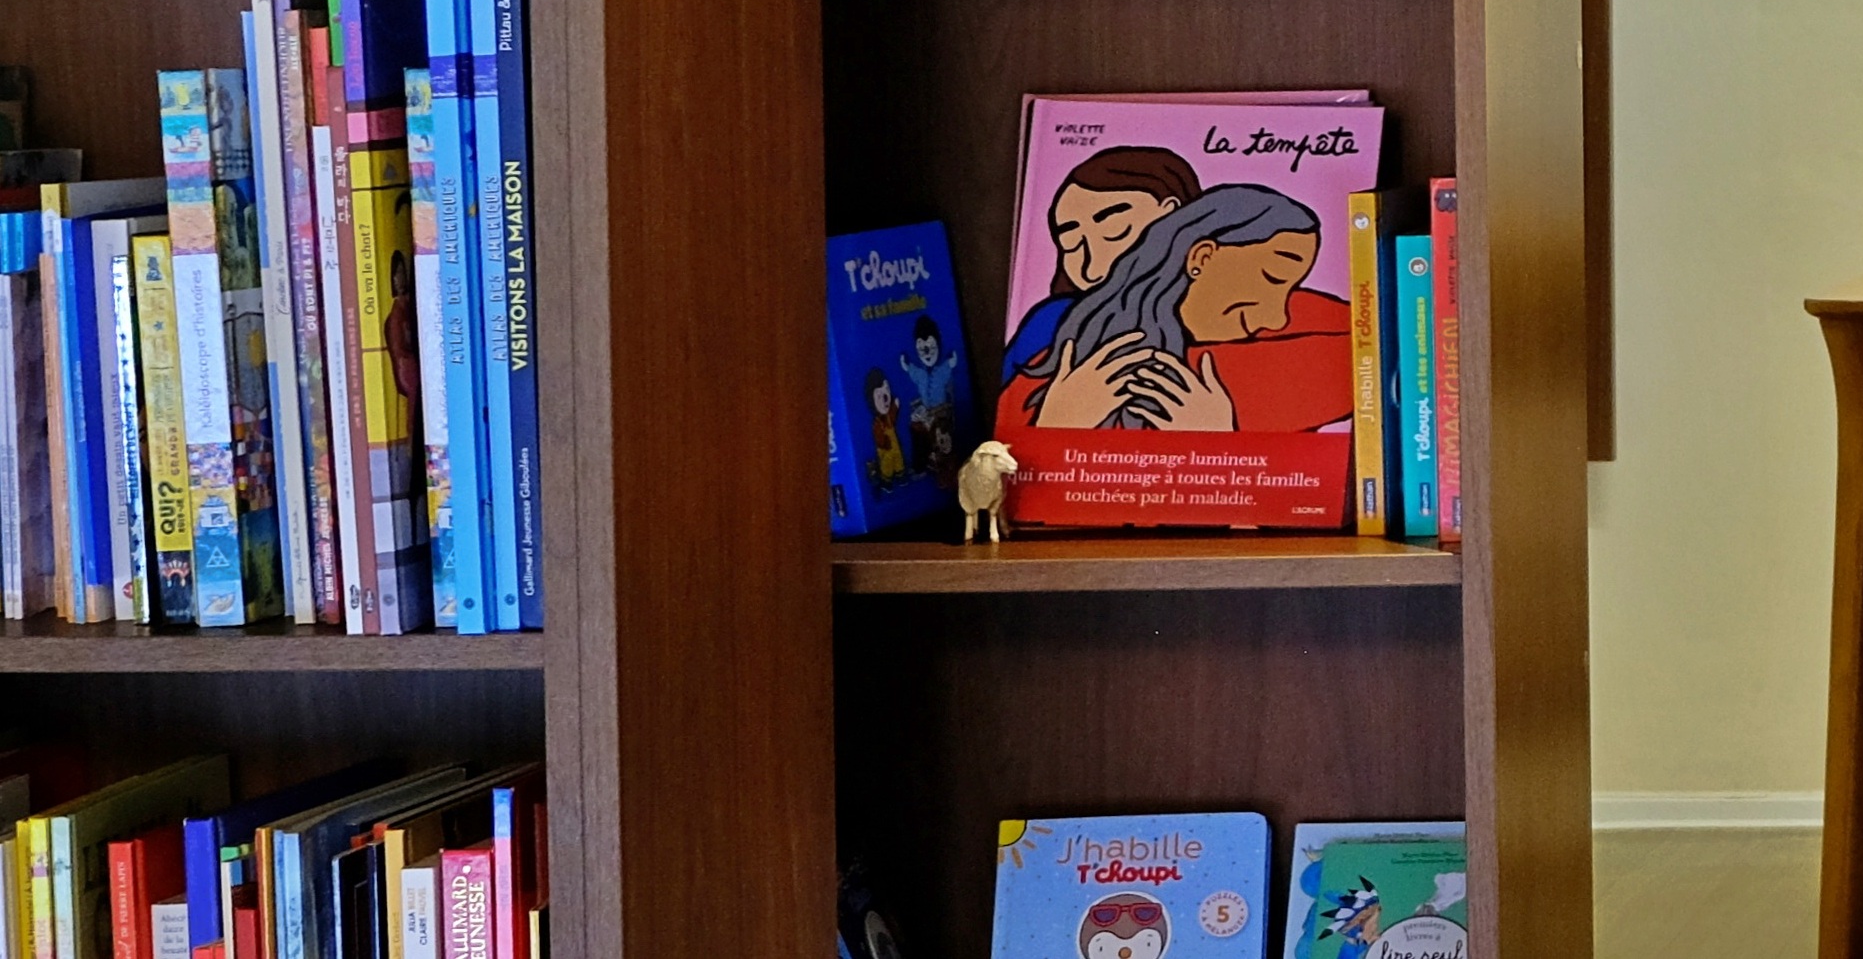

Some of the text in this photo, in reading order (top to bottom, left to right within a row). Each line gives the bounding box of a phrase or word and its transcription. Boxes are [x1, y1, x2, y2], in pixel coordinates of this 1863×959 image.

[499, 12, 513, 51] Pittau
[1203, 125, 1360, 173] La tempête
[360, 263, 372, 274] le
[504, 161, 529, 371] VISITONS LA MAISON
[362, 279, 373, 293] va
[445, 277, 460, 305] DES
[488, 274, 503, 302] DES
[360, 297, 374, 315] Où
[448, 318, 464, 364] ATLAS
[491, 315, 508, 361] ATLAS
[1064, 449, 1268, 468] Un témoignage lumineux
[1037, 469, 1075, 483] rend
[1079, 469, 1161, 489] hommage
[1164, 471, 1174, 484] à
[1178, 473, 1226, 486] toutes
[1231, 472, 1252, 486] les
[1256, 472, 1321, 488] familles
[1065, 488, 1258, 509] touchées par la maladie.
[519, 447, 536, 596] Gallimard Jeunesse Giboulées
[1056, 831, 1204, 864] J'habille
[117, 861, 128, 889] LAPIN
[1076, 859, 1183, 886] T'choupi
[117, 891, 128, 923] PIERRE
[1217, 905, 1230, 923] 5
[1420, 938, 1464, 959] seul
